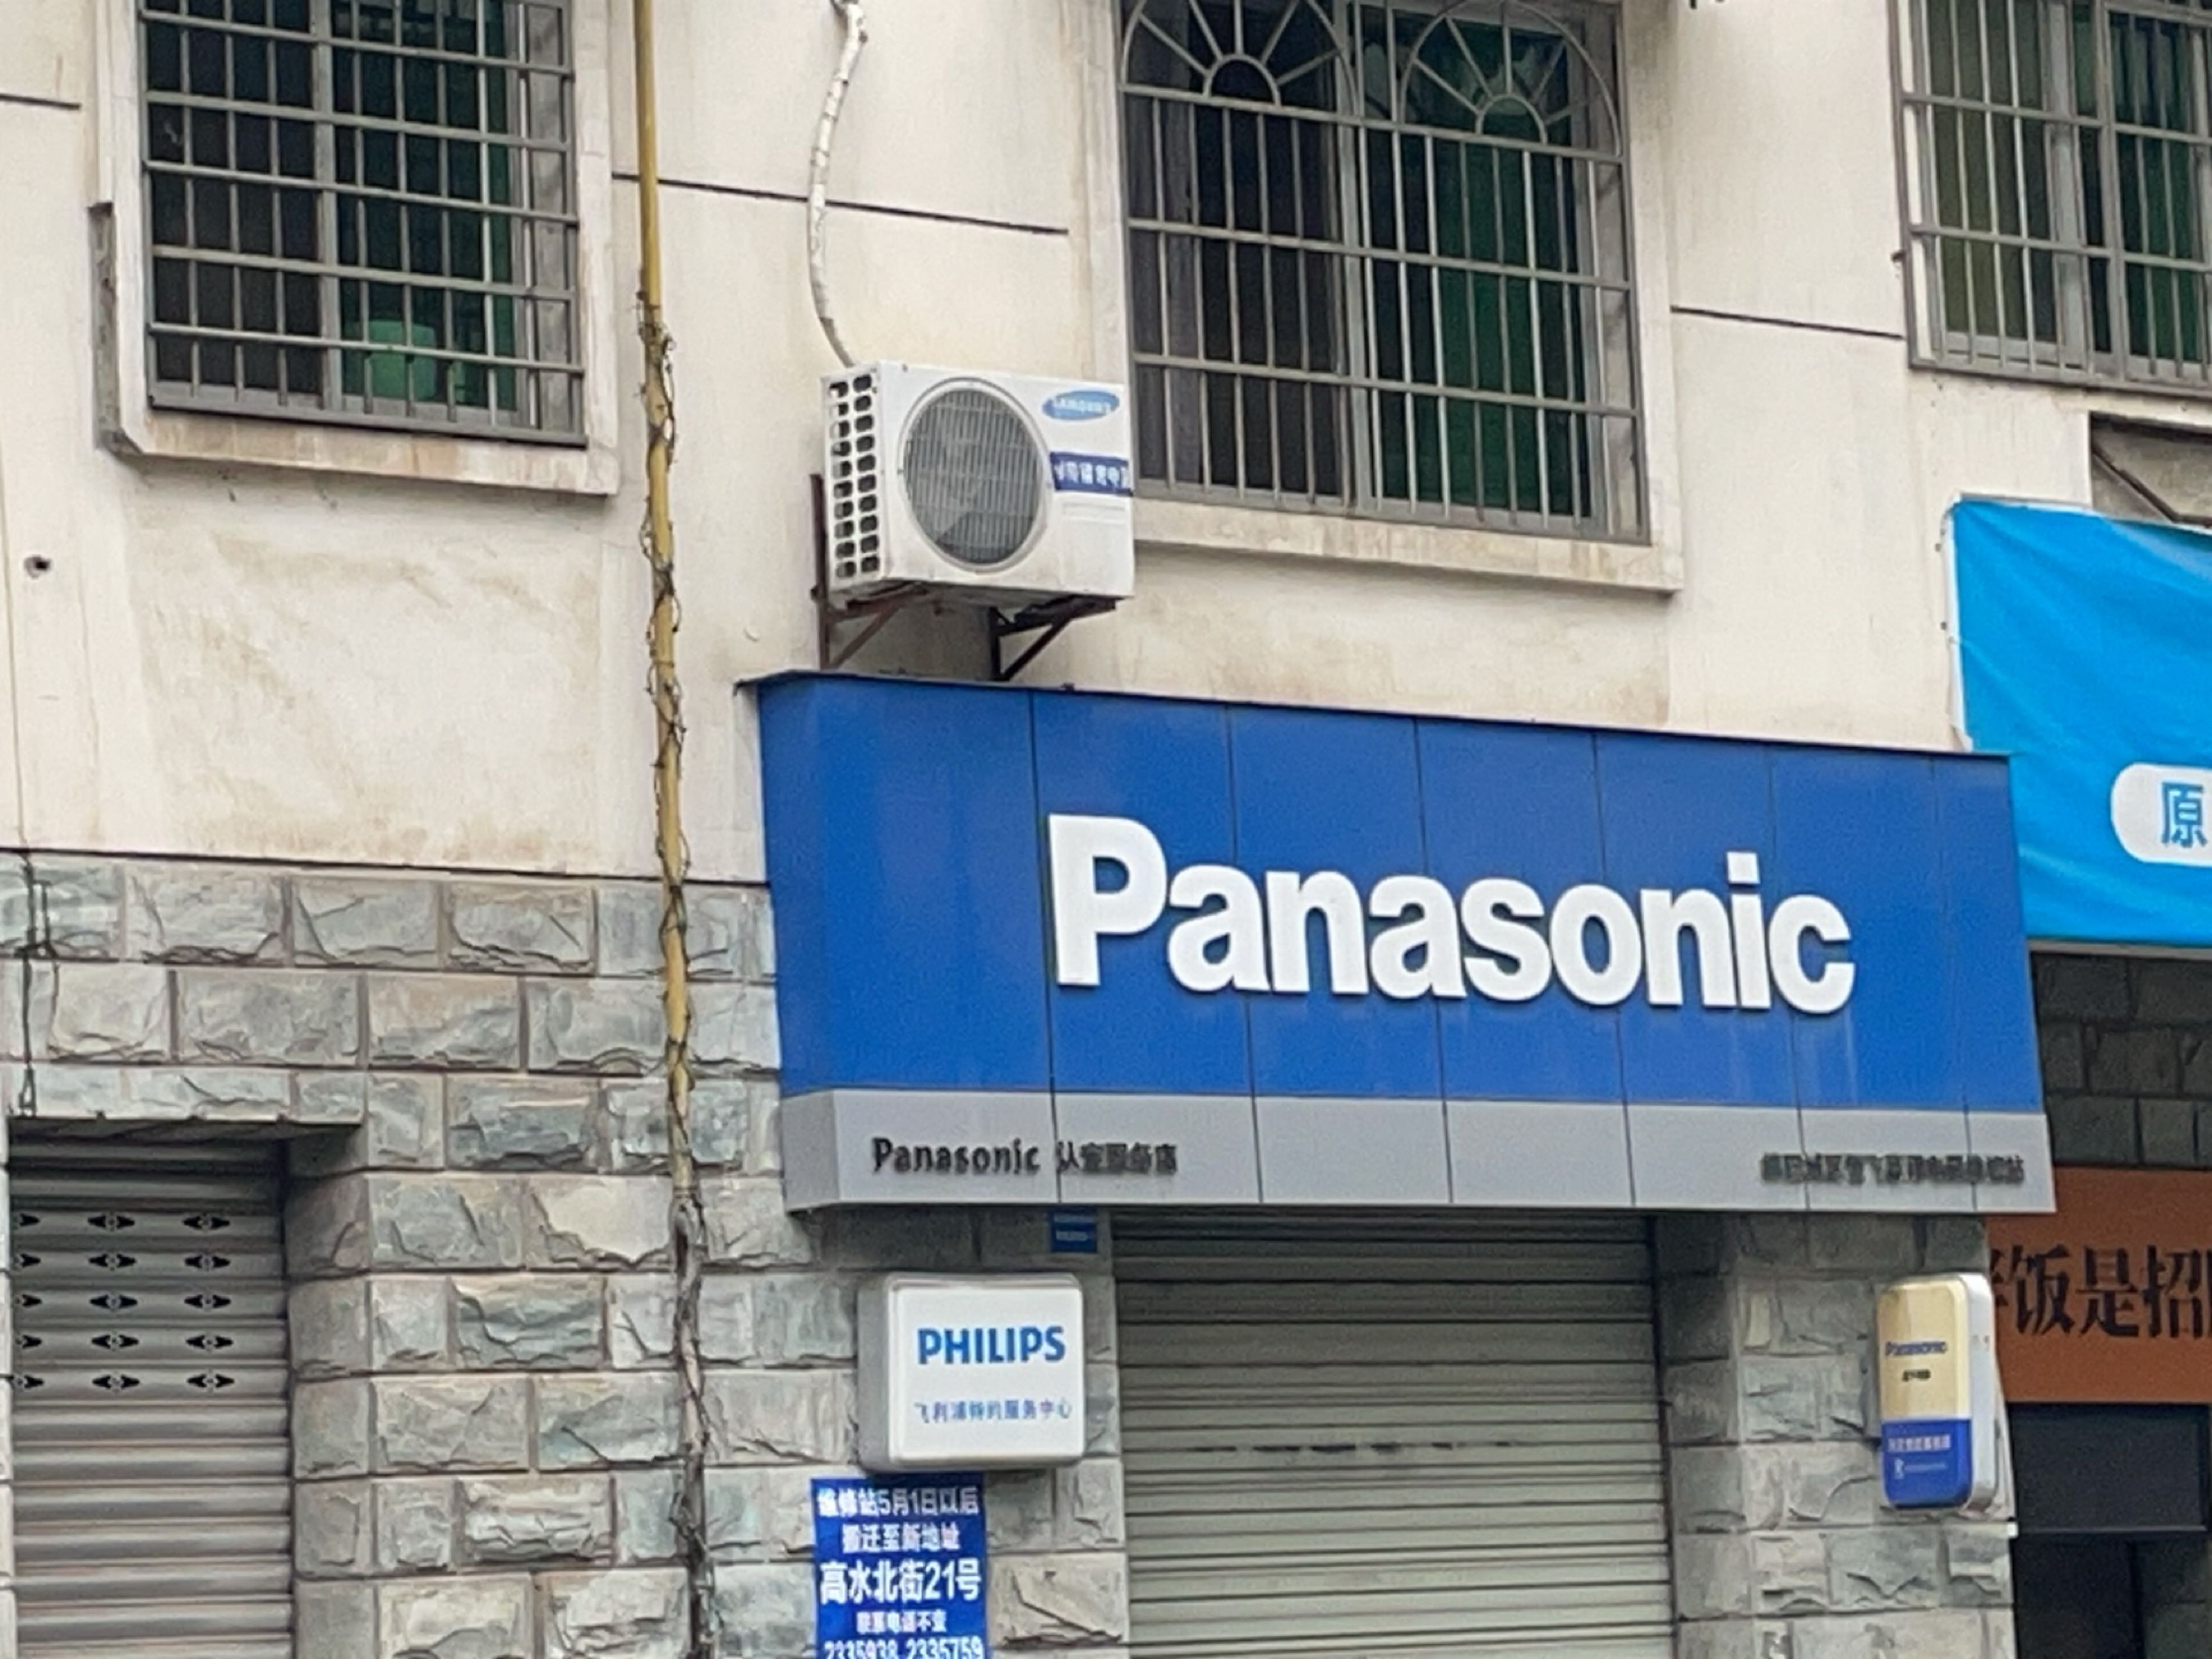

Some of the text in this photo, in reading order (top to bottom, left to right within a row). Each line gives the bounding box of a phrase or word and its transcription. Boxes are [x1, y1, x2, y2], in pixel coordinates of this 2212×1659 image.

[2161, 781, 2208, 848] 原
[1048, 813, 1855, 1014] Panasonic
[872, 1137, 1041, 1175] Panasonic
[917, 1326, 1066, 1365] PHILIPS
[914, 1397, 1073, 1424] 飞利浦特约服务中心
[818, 1486, 979, 1517] 维修站5月1日以后
[819, 1557, 982, 1605] 高水北街21号
